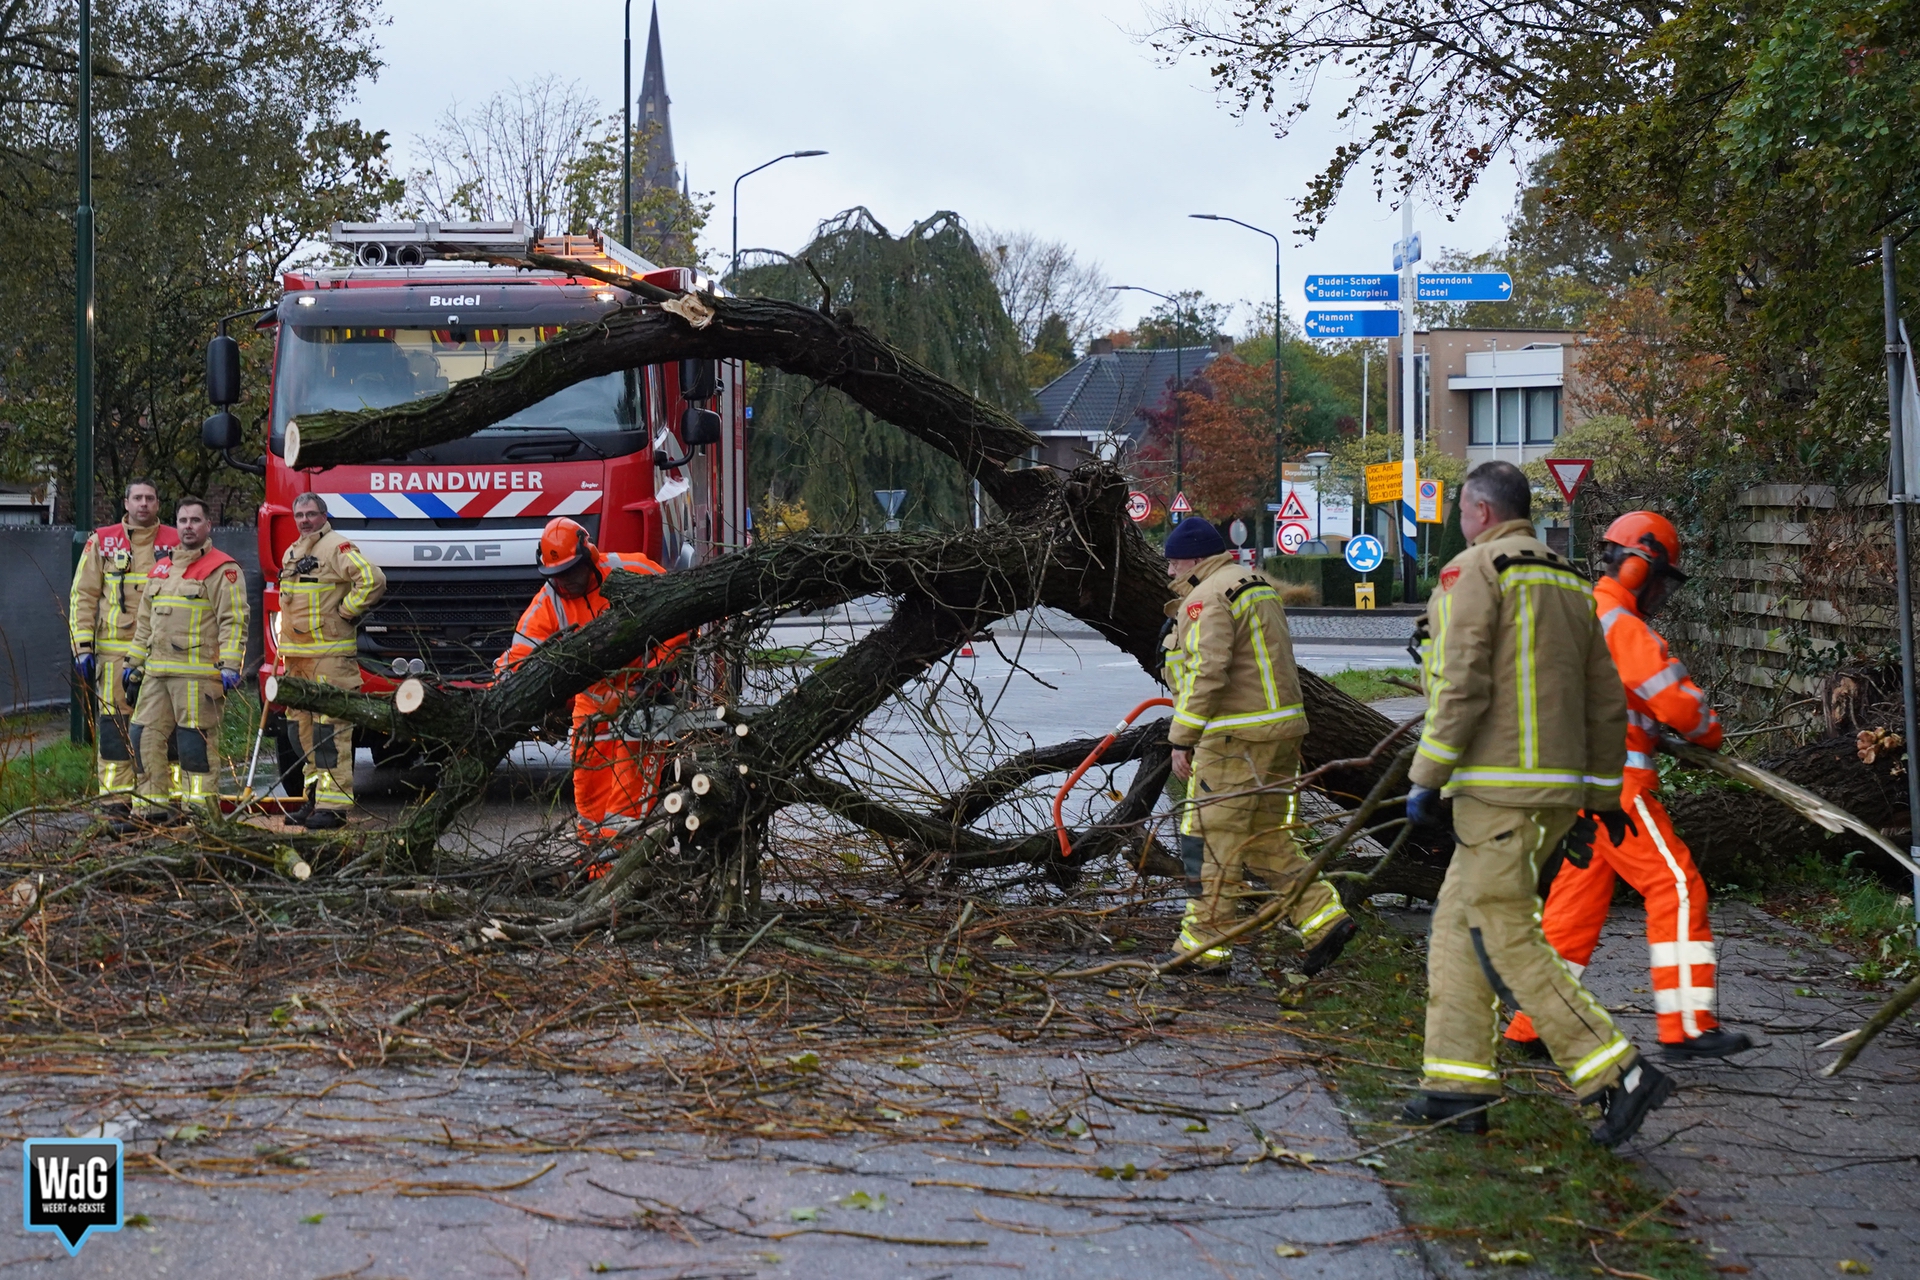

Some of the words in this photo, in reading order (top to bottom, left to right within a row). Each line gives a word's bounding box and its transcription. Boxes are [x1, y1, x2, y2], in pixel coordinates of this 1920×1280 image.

[1318, 277, 1381, 286] Budel-Schoot
[1419, 276, 1473, 285] Soerendonk
[1318, 289, 1389, 298] Budel-Dorplein
[1419, 288, 1448, 297] Gastel
[429, 294, 481, 306] Budel
[1318, 313, 1354, 321] Hamont
[1318, 325, 1344, 333] Weert
[370, 471, 544, 490] BRANDWEER
[1370, 483, 1385, 492] dicht
[104, 536, 124, 548] BV
[1284, 533, 1304, 546] 30
[413, 545, 502, 561] DAF
[153, 564, 170, 575] BV
